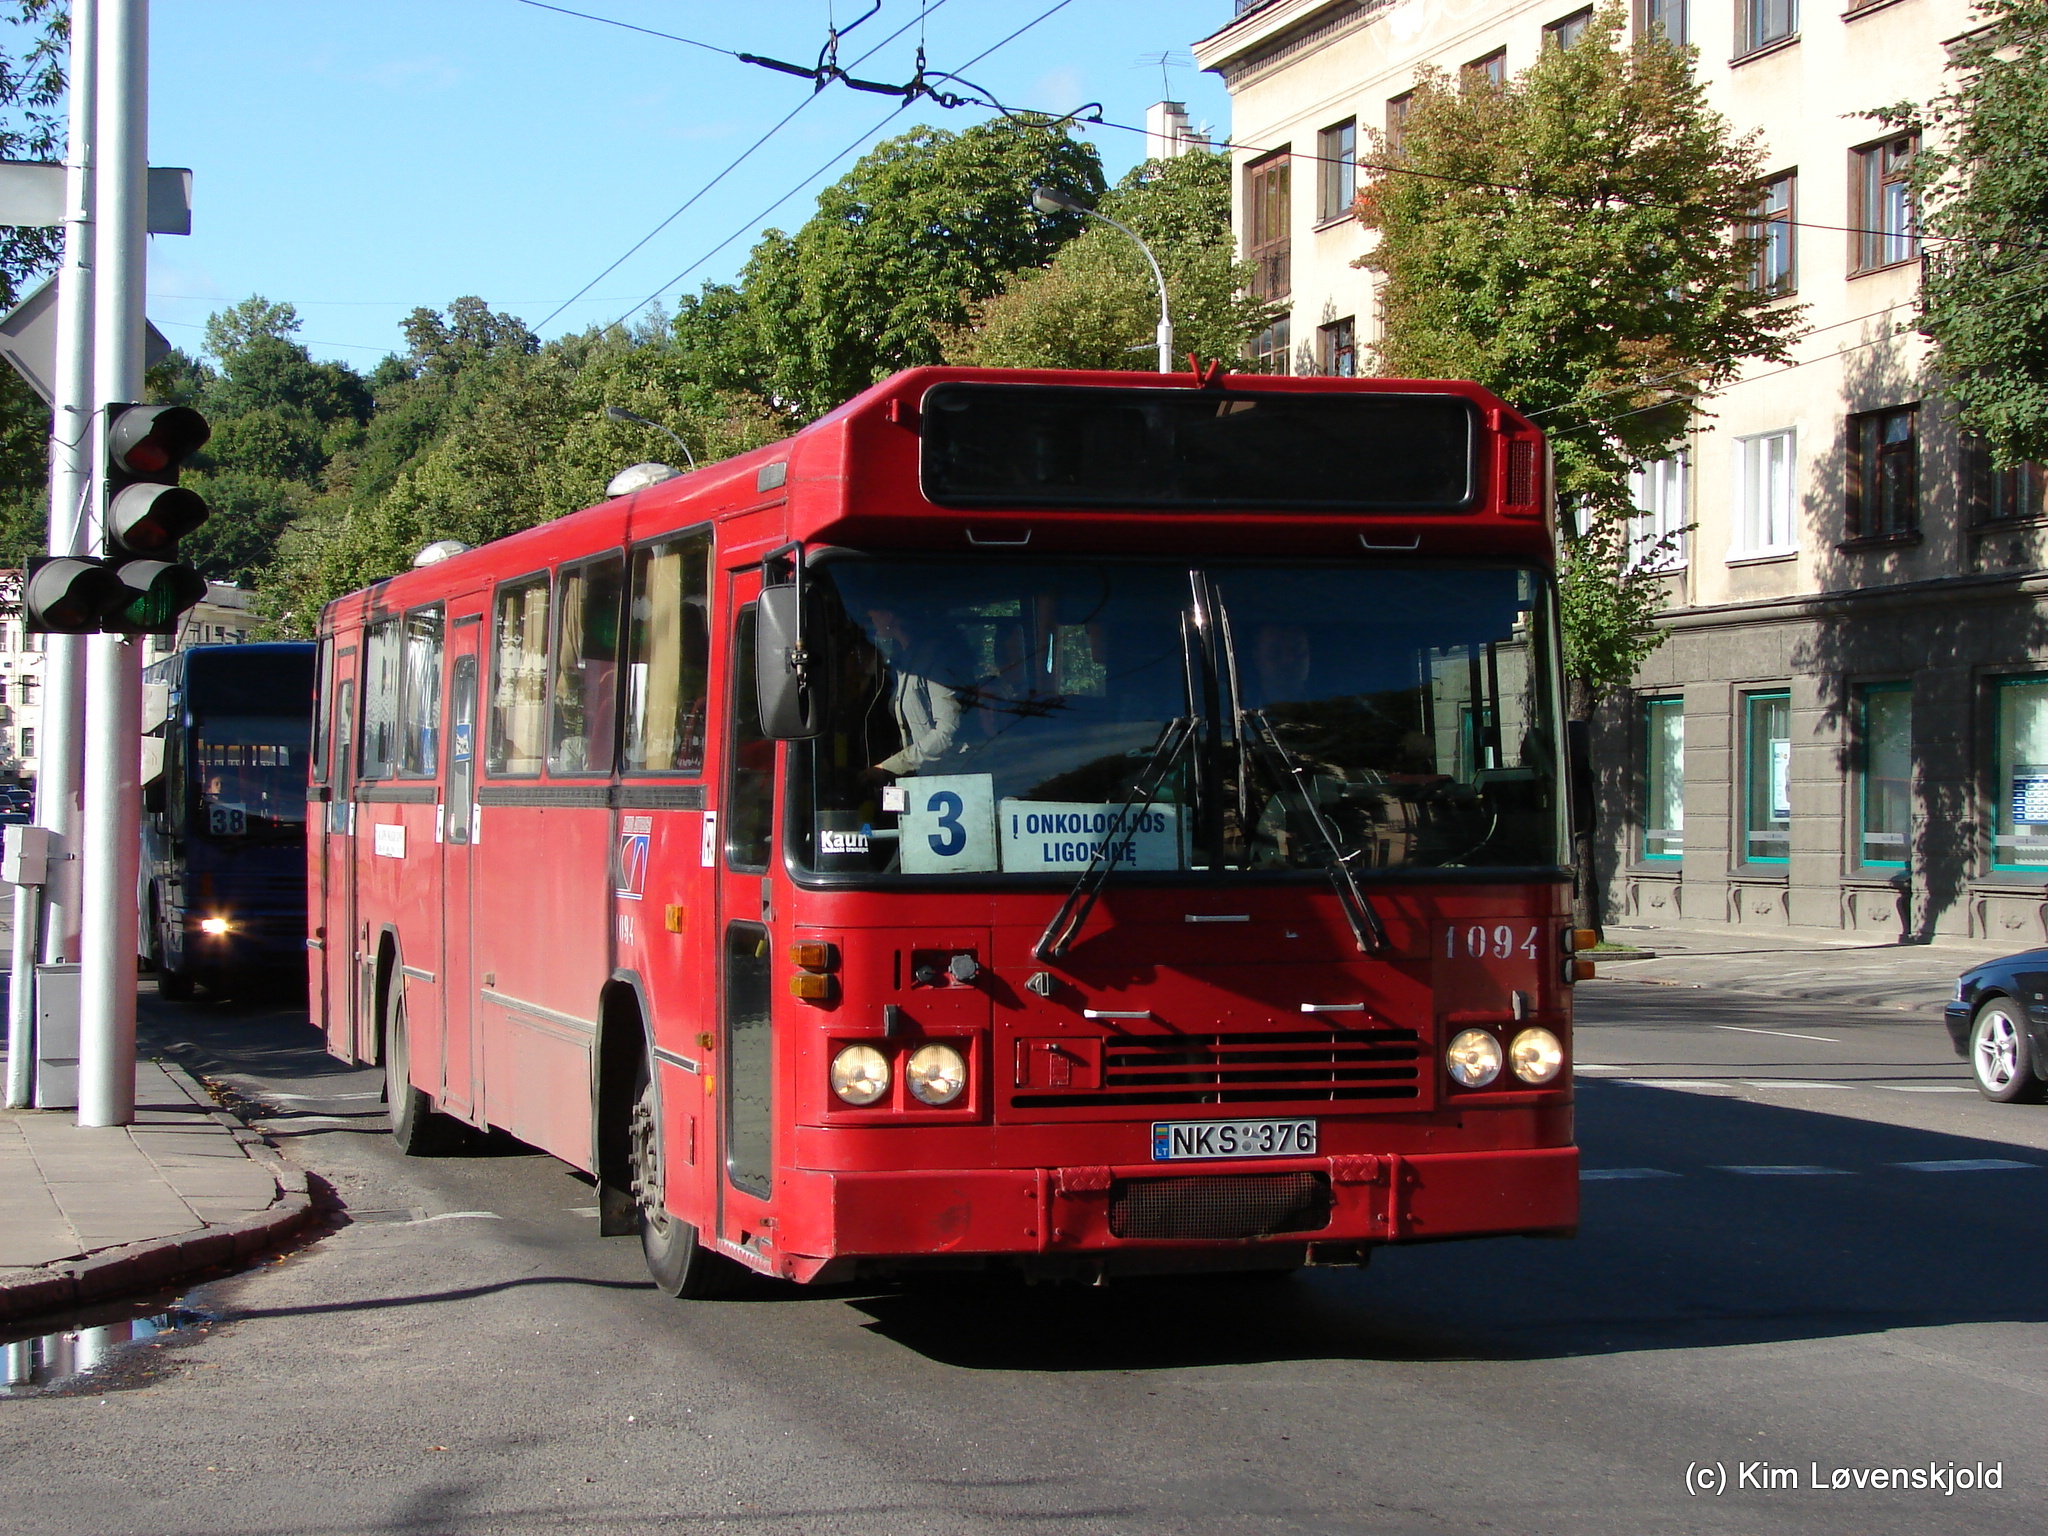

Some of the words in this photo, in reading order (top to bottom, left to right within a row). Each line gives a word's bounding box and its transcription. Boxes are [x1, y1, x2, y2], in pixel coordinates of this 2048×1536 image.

[212, 810, 244, 833] 38
[926, 790, 967, 857] 3
[1012, 814, 1019, 839] Į
[1026, 813, 1165, 834] ONKOLOGIJOS
[1043, 842, 1137, 866] LIGONINĘ
[1446, 925, 1538, 960] 1094
[1156, 1147, 1168, 1156] LT
[1172, 1126, 1237, 1155] NKS
[1258, 1124, 1311, 1152] 376
